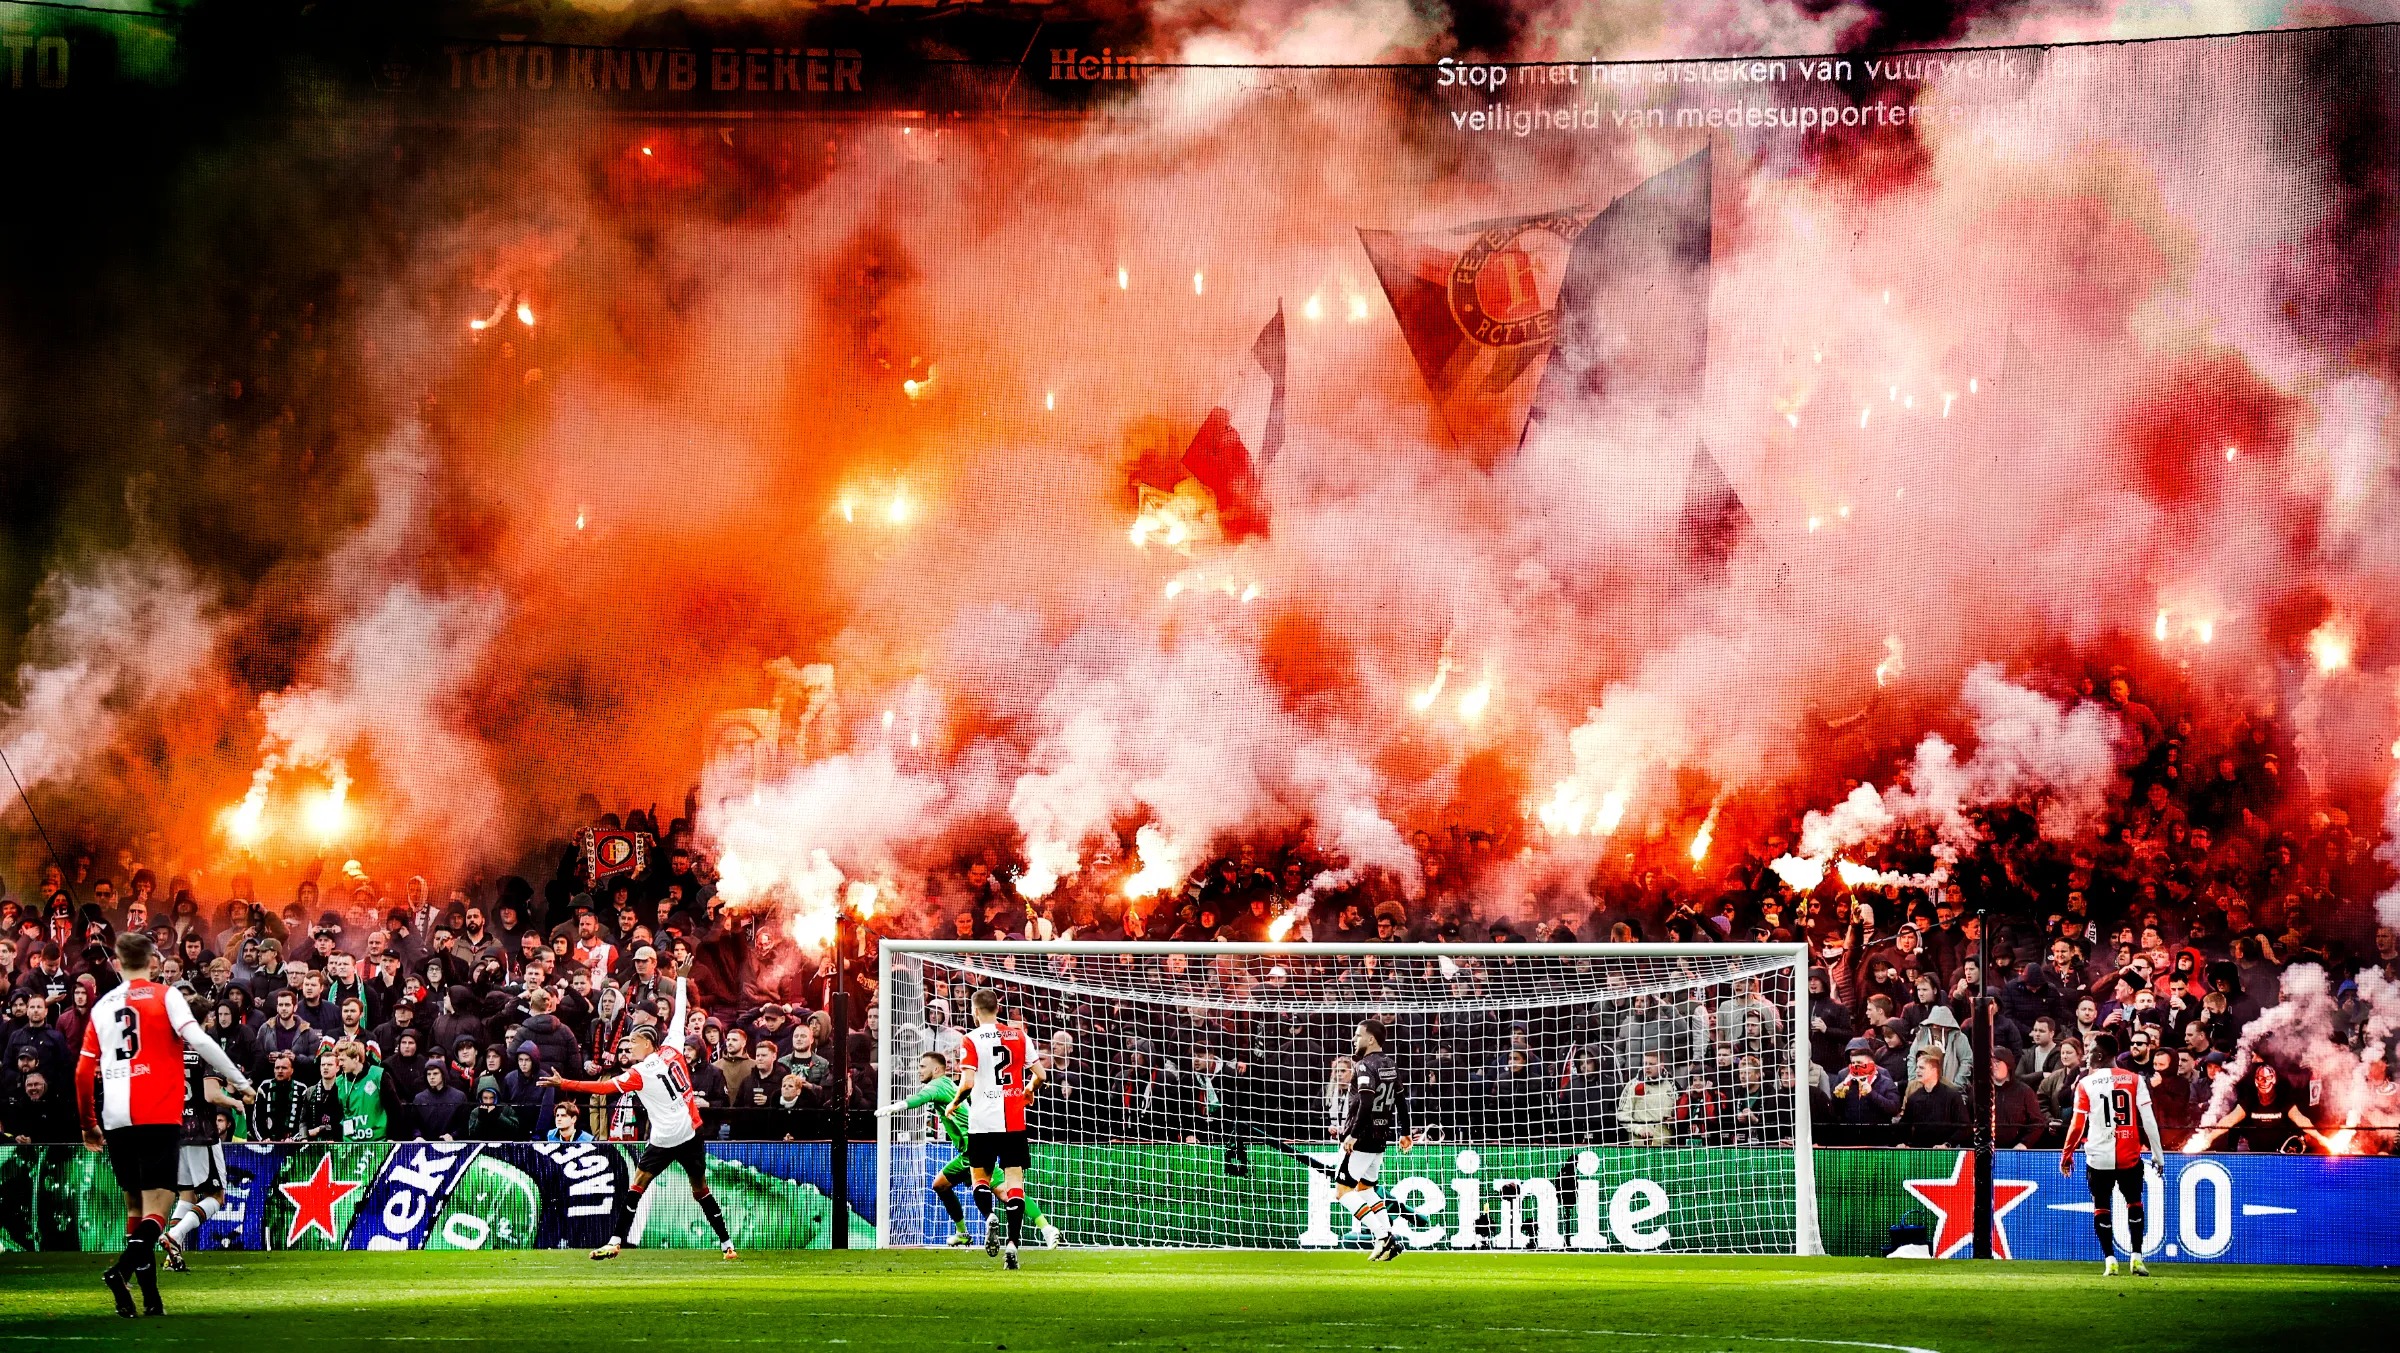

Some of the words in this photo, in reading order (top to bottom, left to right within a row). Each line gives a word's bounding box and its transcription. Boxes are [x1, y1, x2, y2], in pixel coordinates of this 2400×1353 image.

[444, 42, 553, 89] TOTO
[568, 46, 697, 91] KNVB
[711, 48, 863, 92] BEKER
[1437, 57, 1508, 93] Stop
[1519, 60, 1580, 85] met
[1798, 60, 1852, 82] van
[1450, 102, 1600, 138] veiligheid
[1611, 106, 1665, 129] van
[1676, 98, 1937, 135] medesupporters
[114, 1007, 141, 1061] 3
[656, 1060, 691, 1101] 10
[992, 1045, 1014, 1086] 2
[1371, 1082, 1395, 1112] 24
[2099, 1087, 2133, 1128] 19
